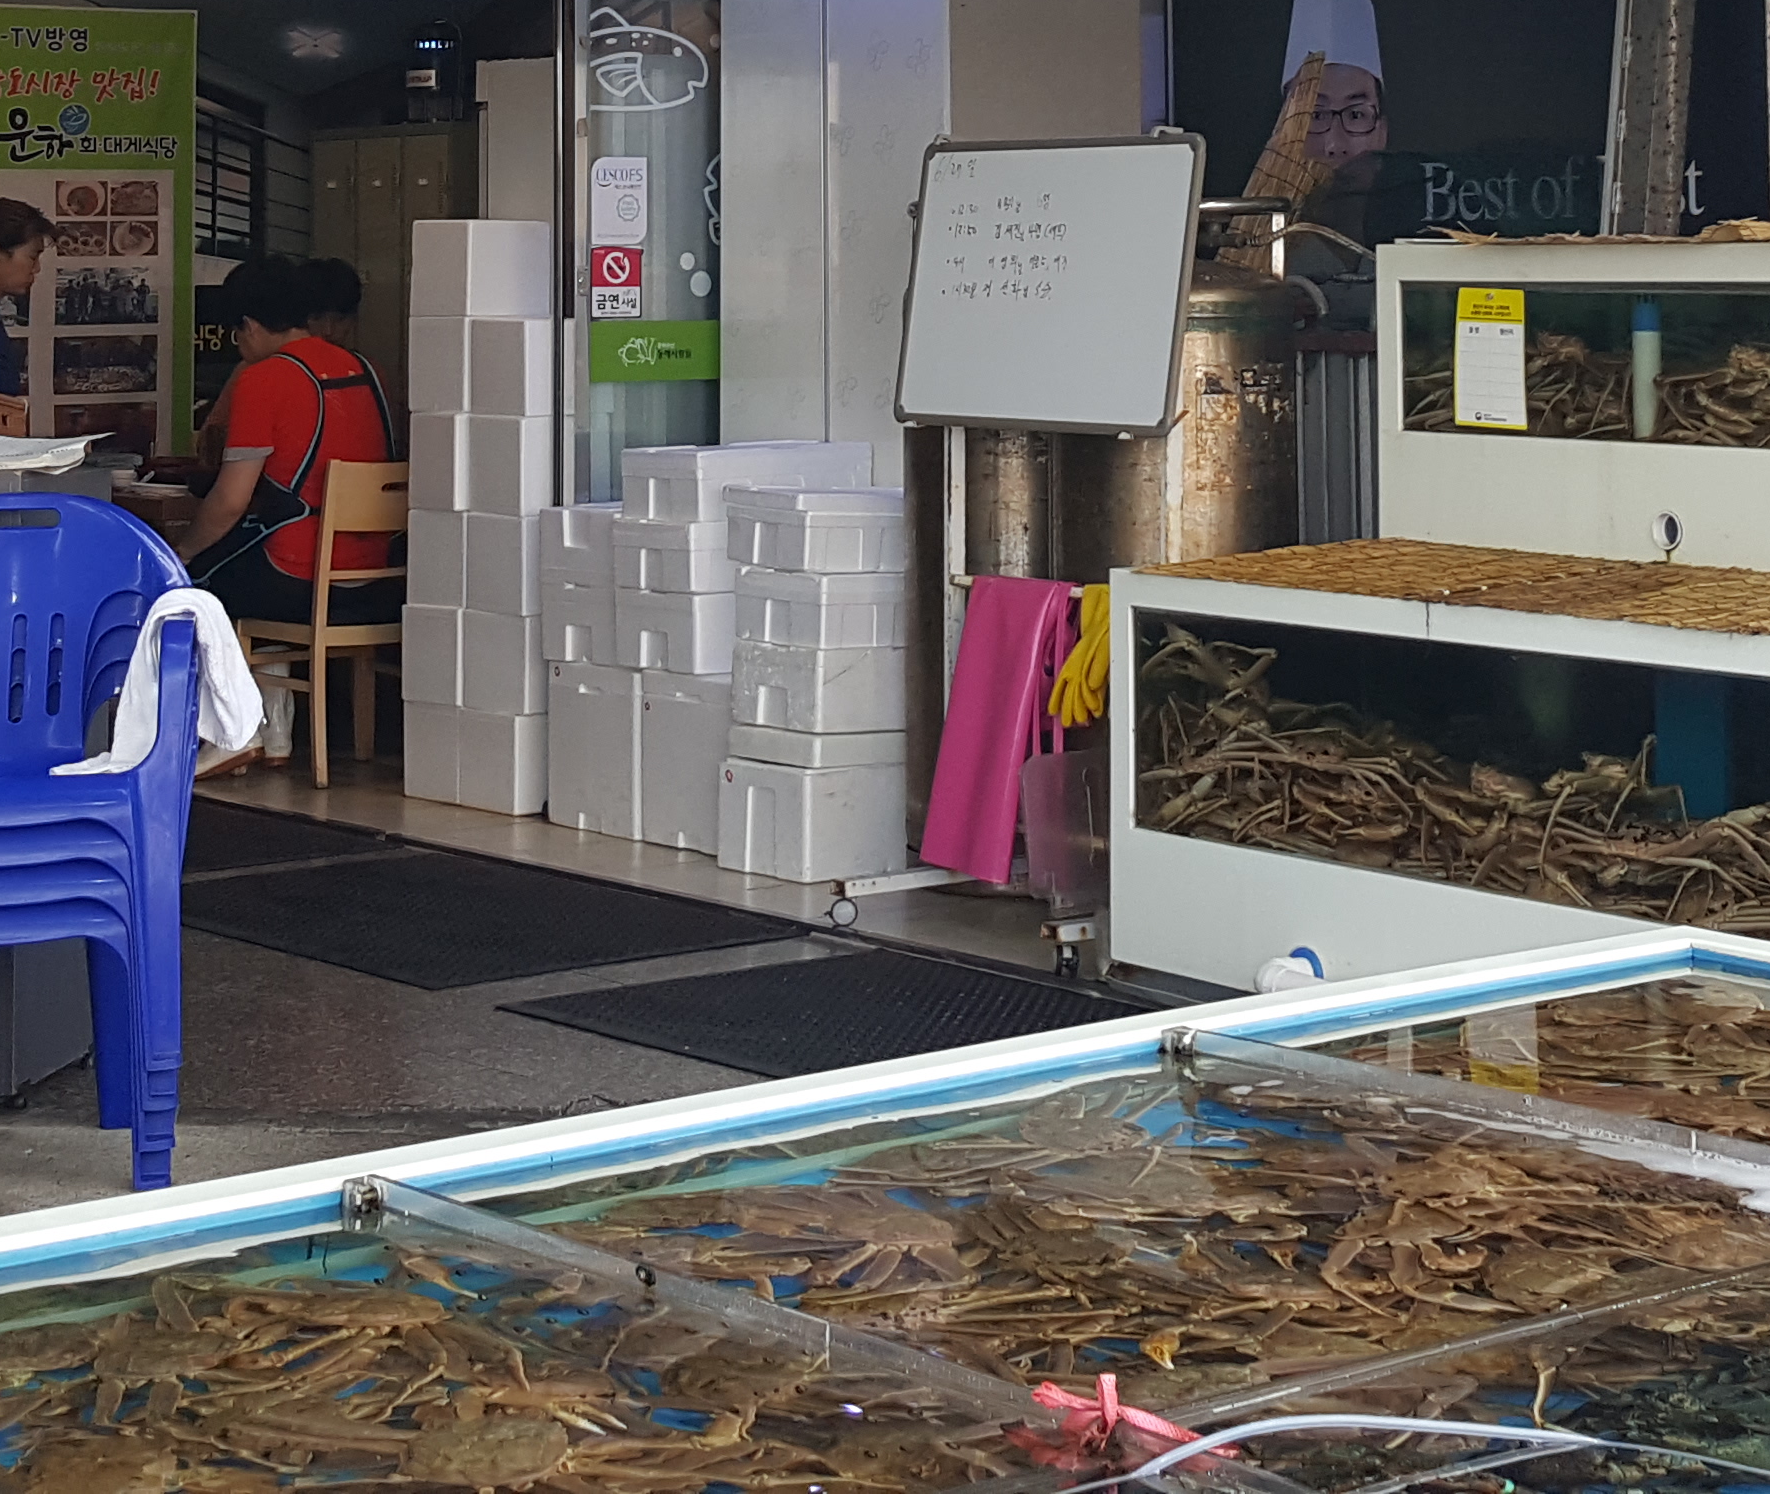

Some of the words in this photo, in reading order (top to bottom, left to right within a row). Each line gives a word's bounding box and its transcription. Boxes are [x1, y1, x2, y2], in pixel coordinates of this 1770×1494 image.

[91, 67, 161, 104] 맛집!
[1419, 162, 1519, 222] Best
[1532, 156, 1579, 219] of
[595, 293, 620, 310] 금연
[622, 297, 637, 309] 시설
